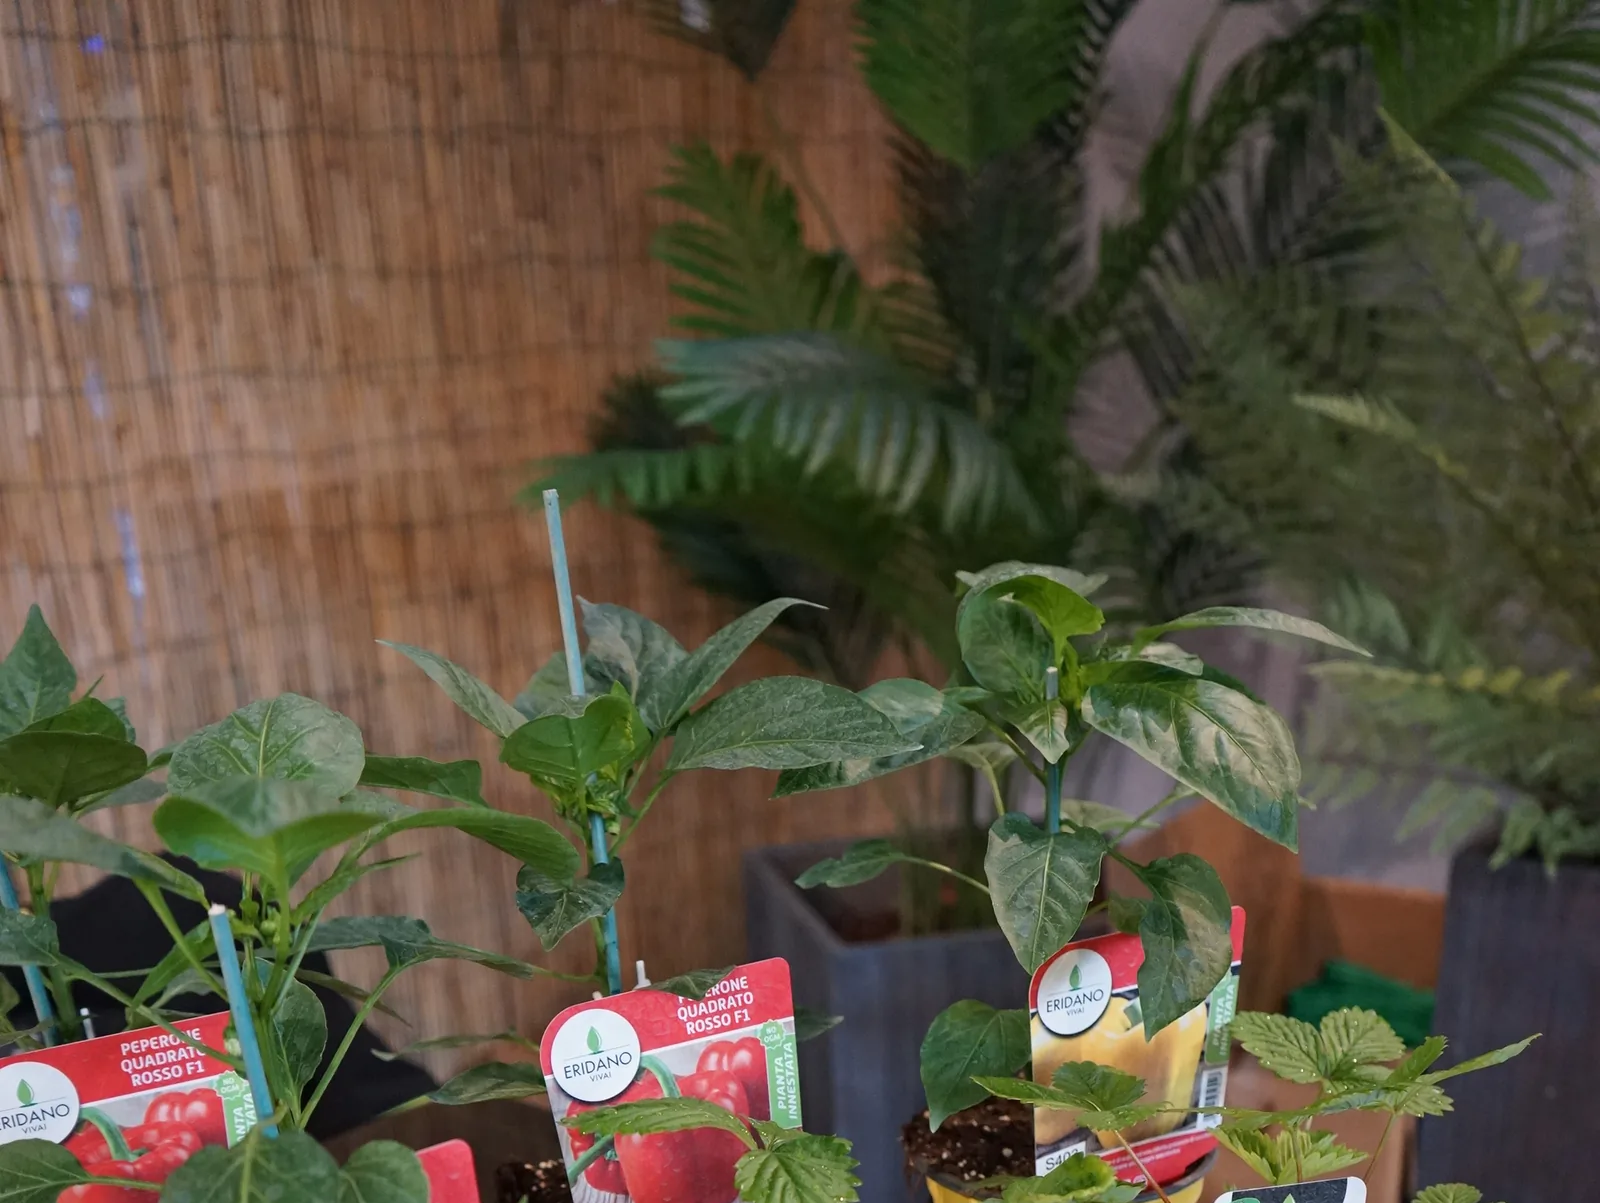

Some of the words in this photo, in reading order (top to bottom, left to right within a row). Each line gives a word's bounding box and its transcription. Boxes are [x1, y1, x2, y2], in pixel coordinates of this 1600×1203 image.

[677, 991, 754, 1022] QUADRATO
[1046, 988, 1104, 1013] ERIDANO
[1066, 1007, 1085, 1017] VIVAI
[686, 1013, 731, 1035] ROSSO
[734, 1008, 751, 1024] F1
[765, 1026, 777, 1035] NO
[1212, 997, 1225, 1046] PIANTA
[131, 1065, 183, 1087] ROSSO
[186, 1060, 205, 1075] F1
[564, 1051, 633, 1080] ERIDANO
[589, 1072, 612, 1083] VIVAI
[774, 1056, 787, 1110] PIANTA
[783, 1041, 798, 1120] INNESTATA
[0, 1103, 70, 1131] RIDANO
[21, 1123, 47, 1134] VIVAI
[233, 1106, 246, 1142] ANTA
